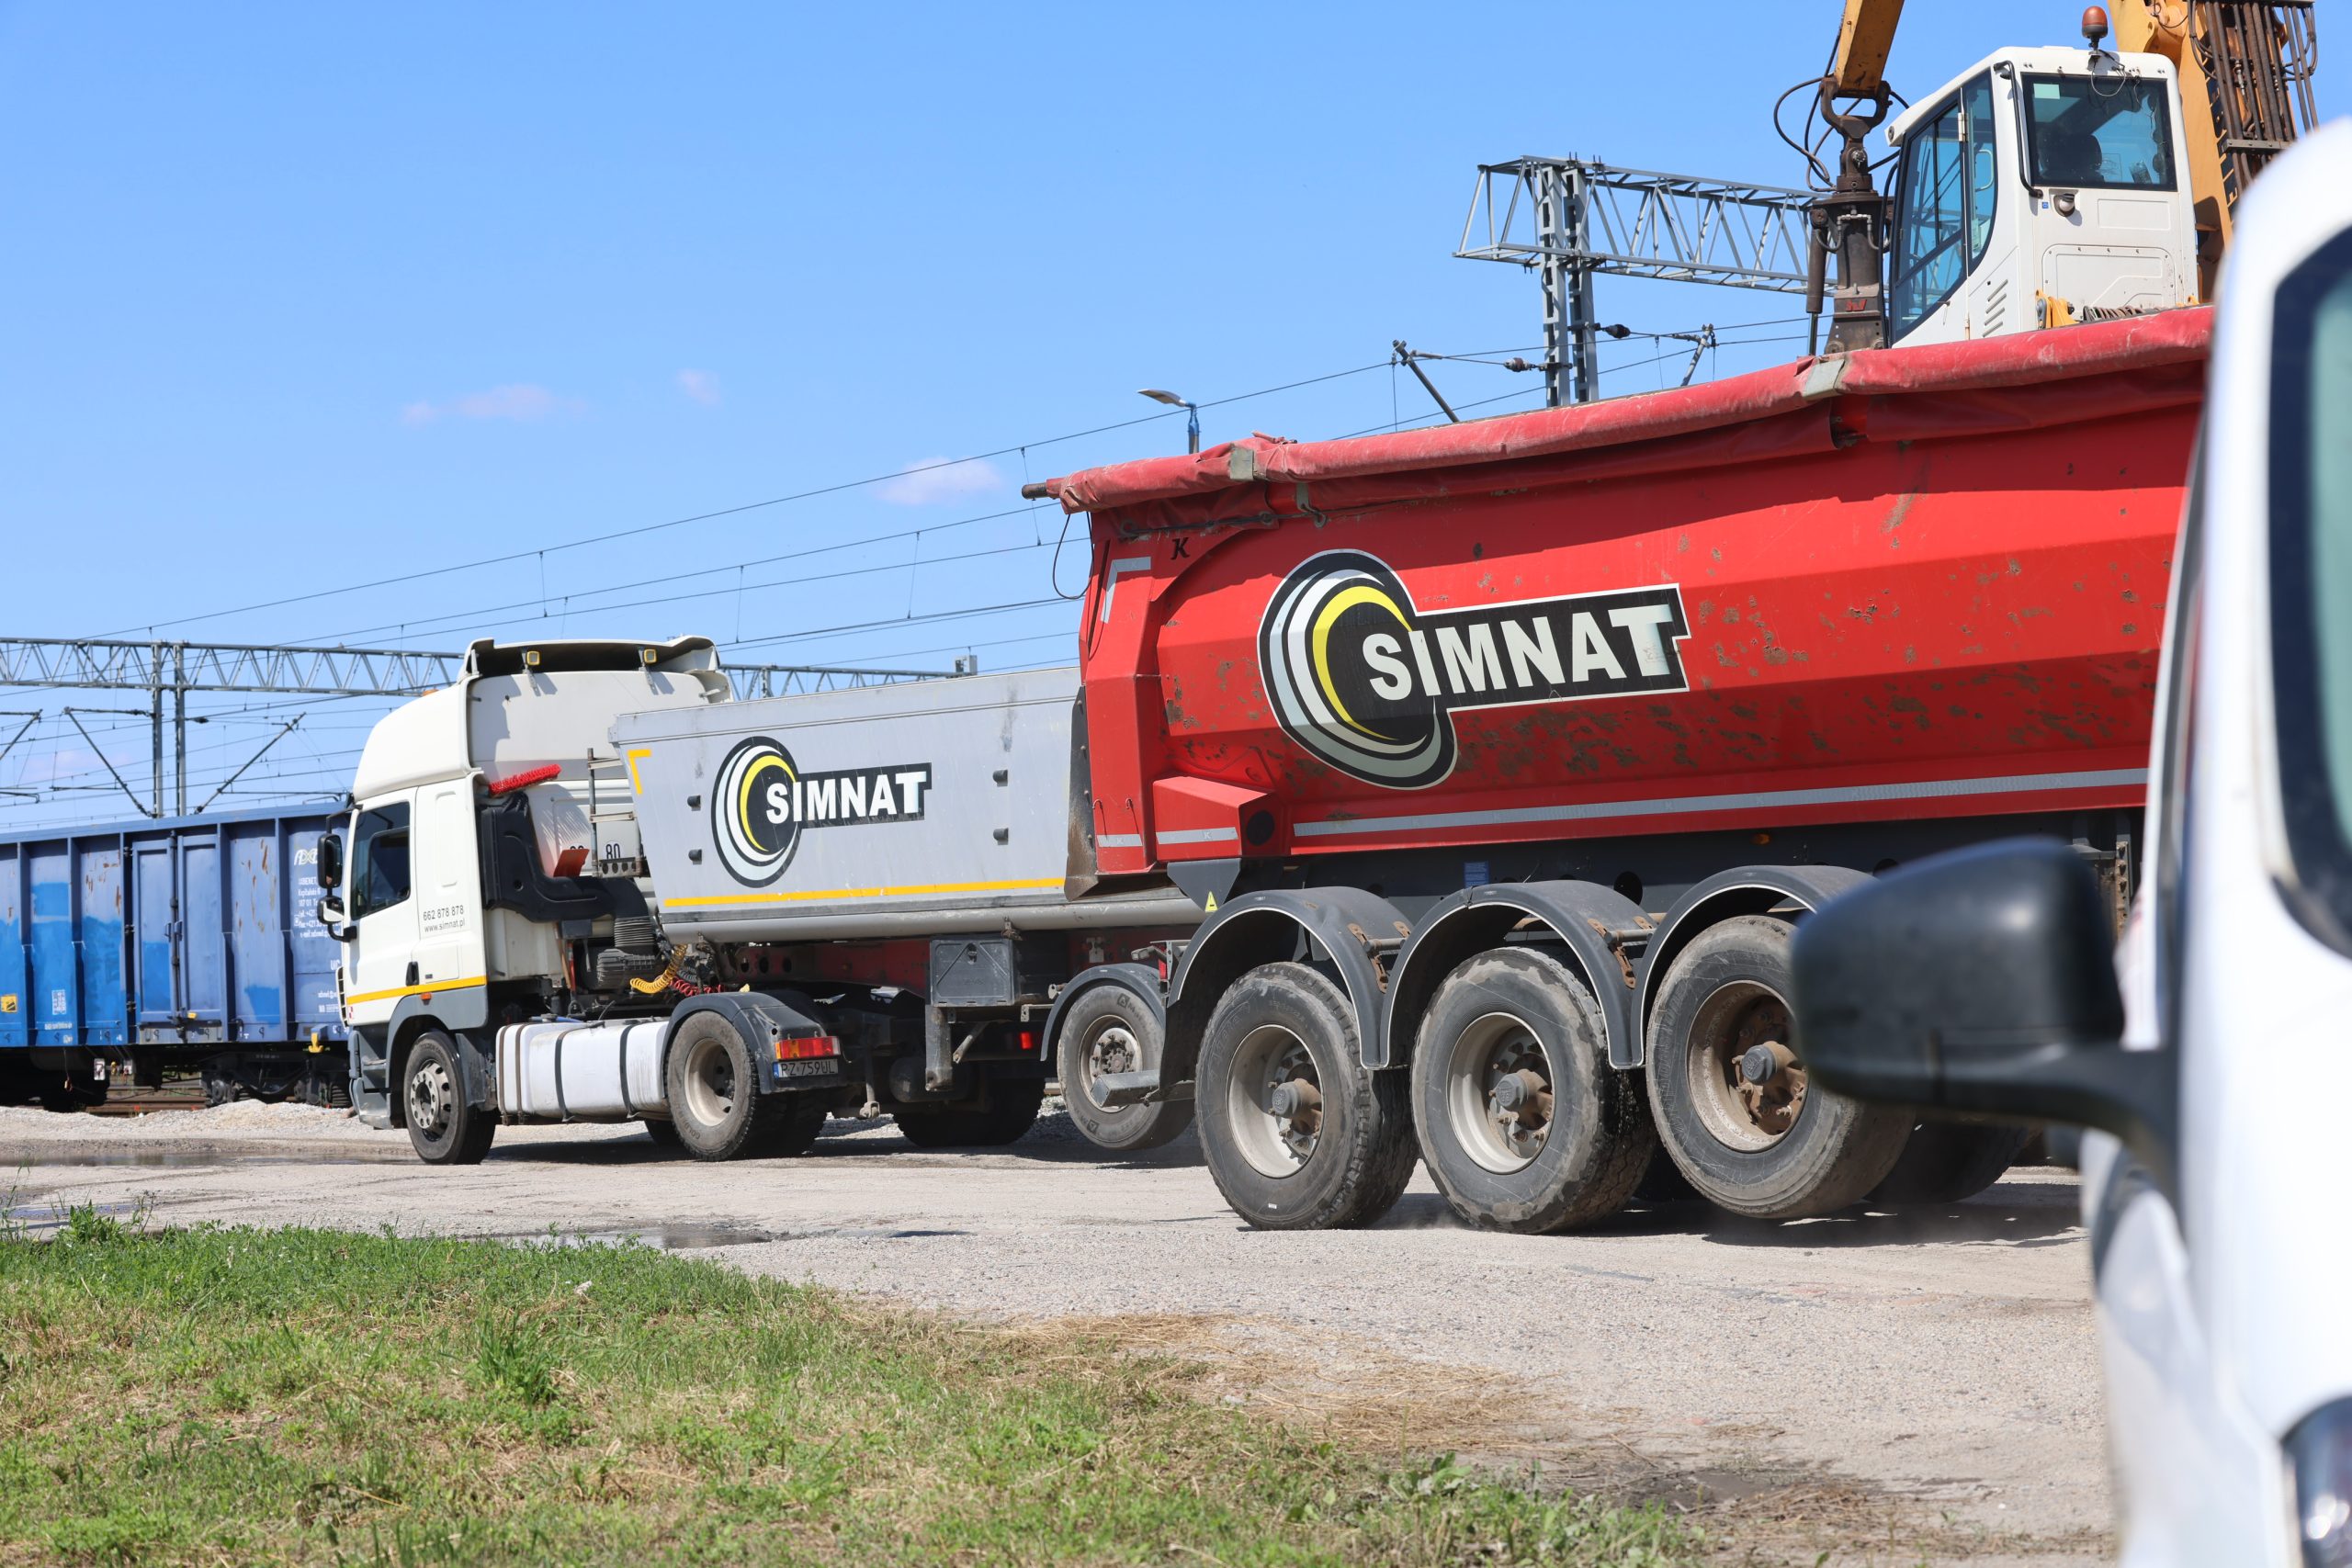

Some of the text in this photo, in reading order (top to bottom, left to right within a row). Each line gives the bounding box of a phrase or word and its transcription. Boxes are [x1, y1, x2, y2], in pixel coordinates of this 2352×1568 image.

[1170, 537, 1190, 559] K
[1363, 604, 1673, 700] SIMNAT
[766, 772, 927, 825] SIMNAT
[606, 843, 620, 859] 80
[424, 905, 463, 921] 662 878 878
[424, 917, 465, 932] www.simnat.pl
